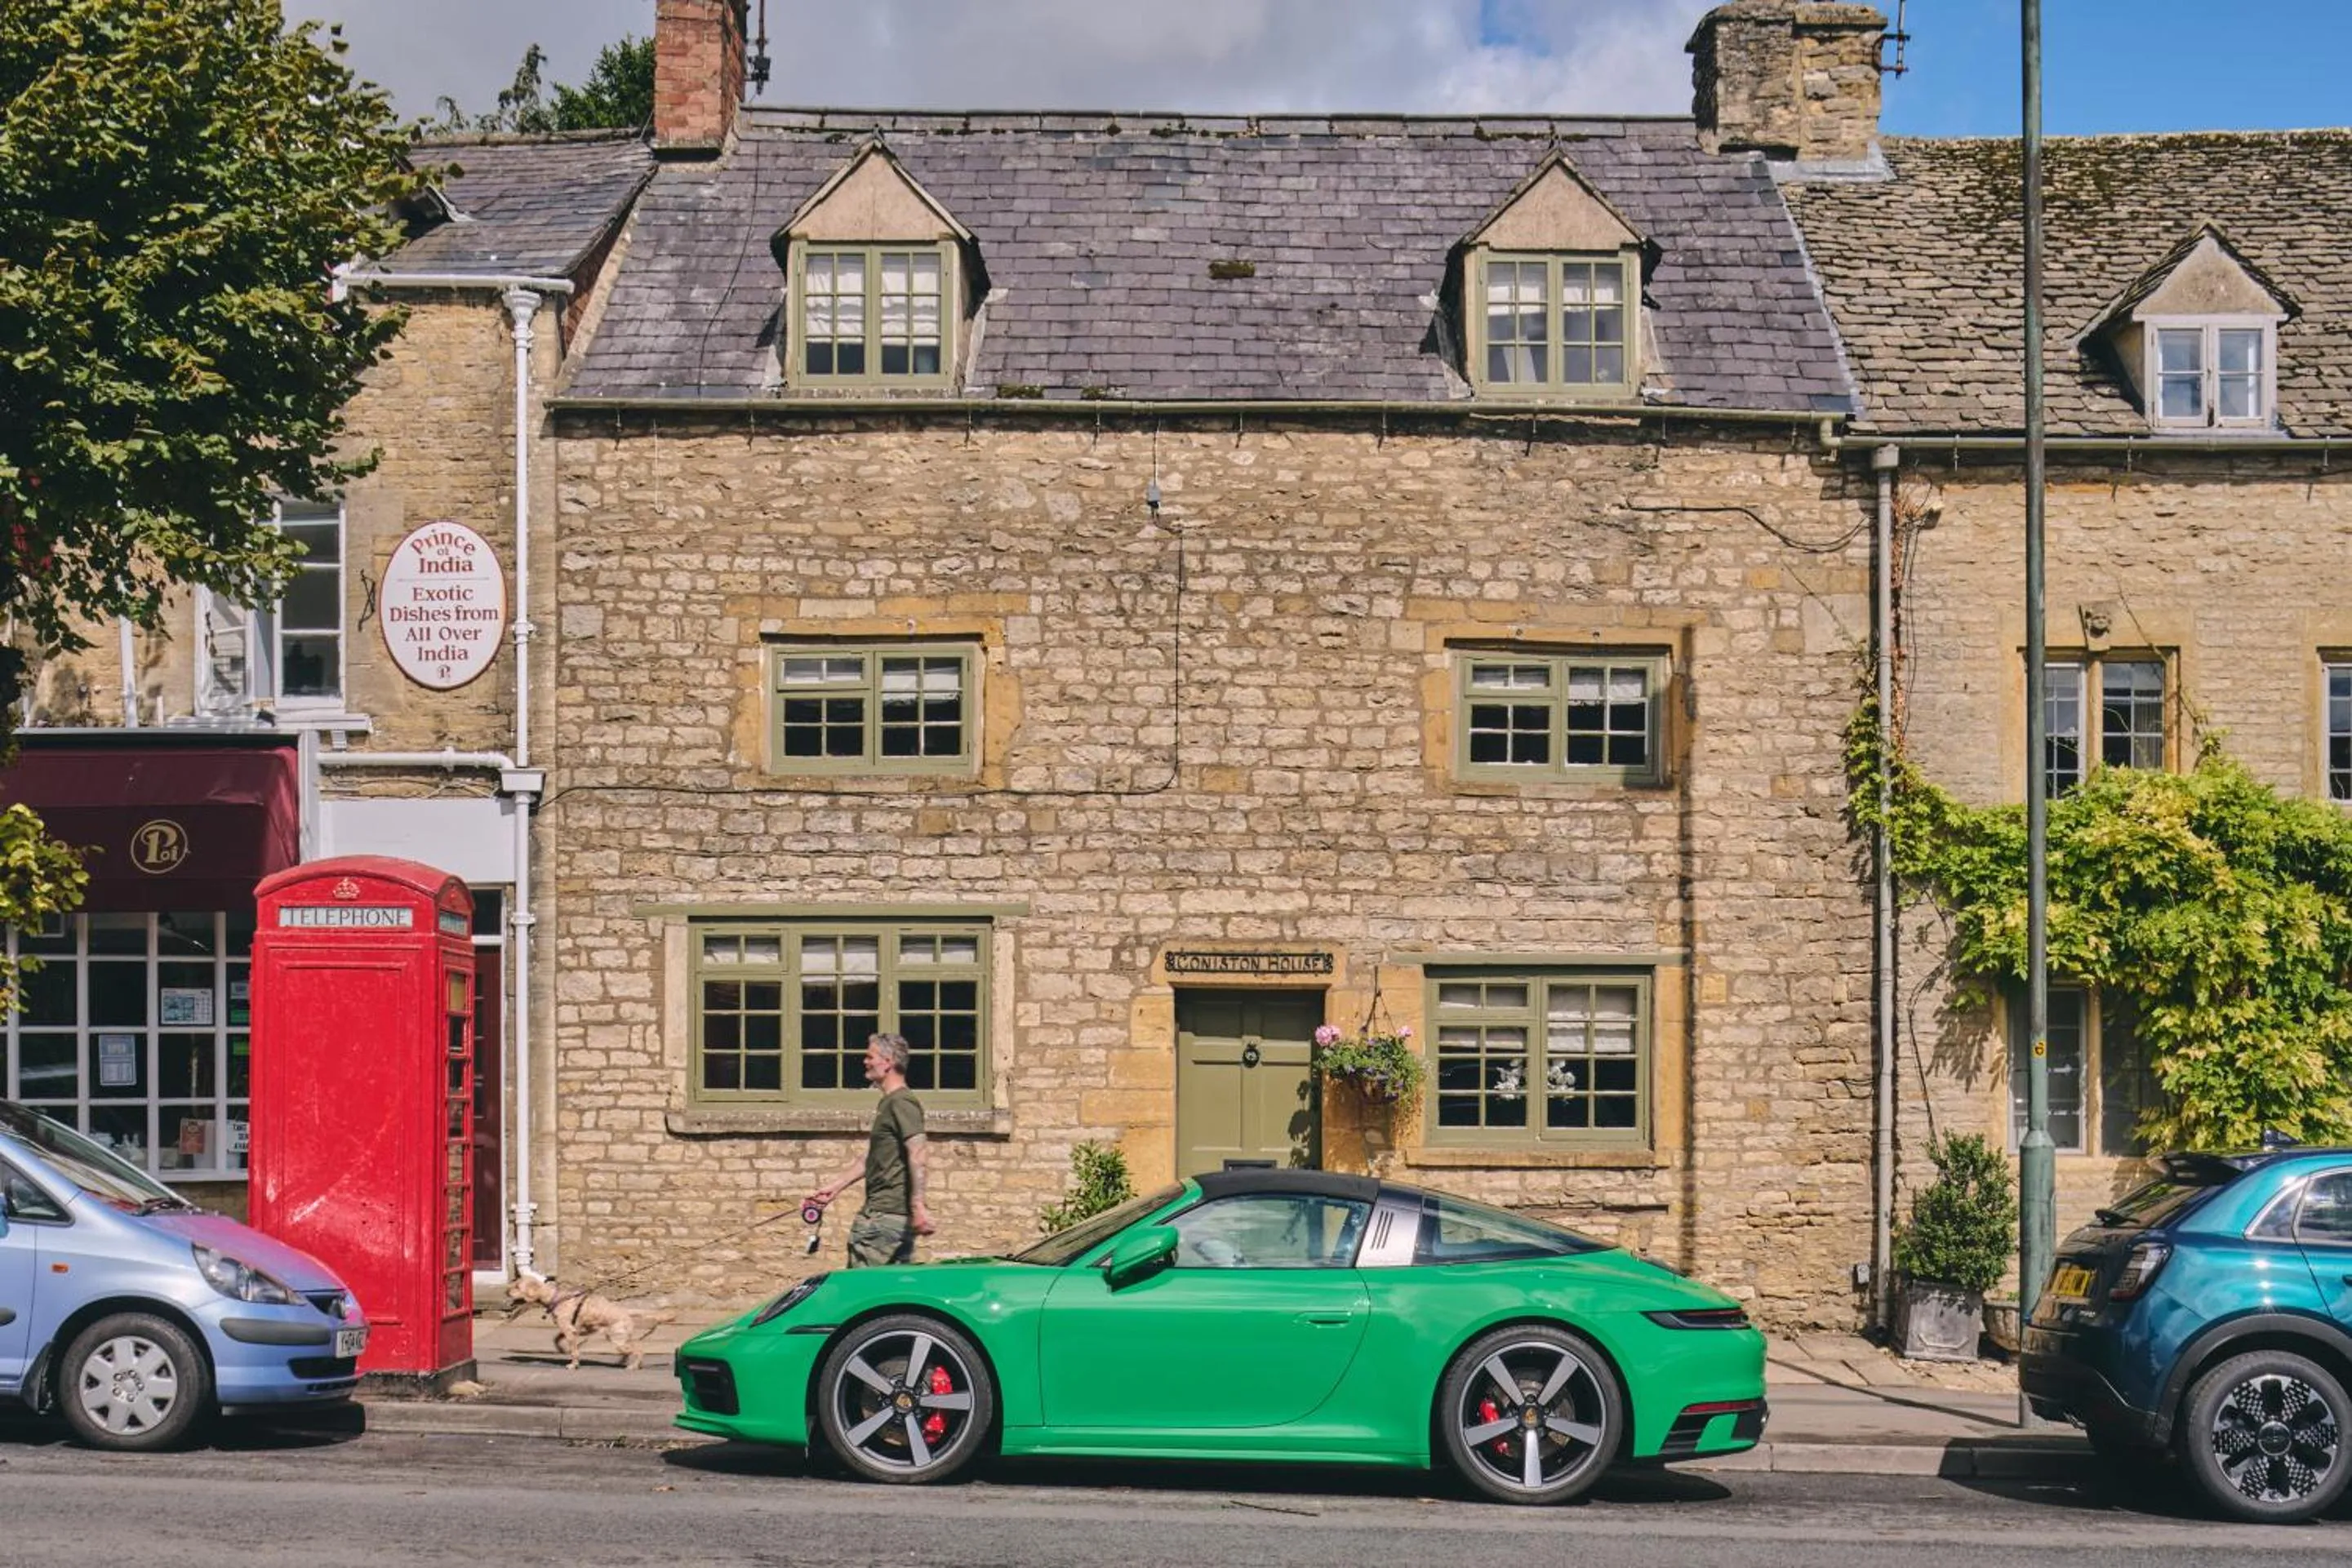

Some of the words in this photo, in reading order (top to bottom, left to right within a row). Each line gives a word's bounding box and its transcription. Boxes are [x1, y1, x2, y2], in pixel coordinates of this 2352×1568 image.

[411, 529, 476, 556] Prince
[419, 557, 474, 573] India
[413, 585, 474, 602] Exotic
[389, 606, 451, 622] Dishes
[455, 605, 499, 620] from
[406, 627, 430, 642] All
[438, 627, 482, 641] Over
[417, 646, 469, 662] India
[289, 907, 407, 926] TELEPHONE
[1177, 955, 1260, 971] CONISTON
[1268, 954, 1321, 972] HOUSE
